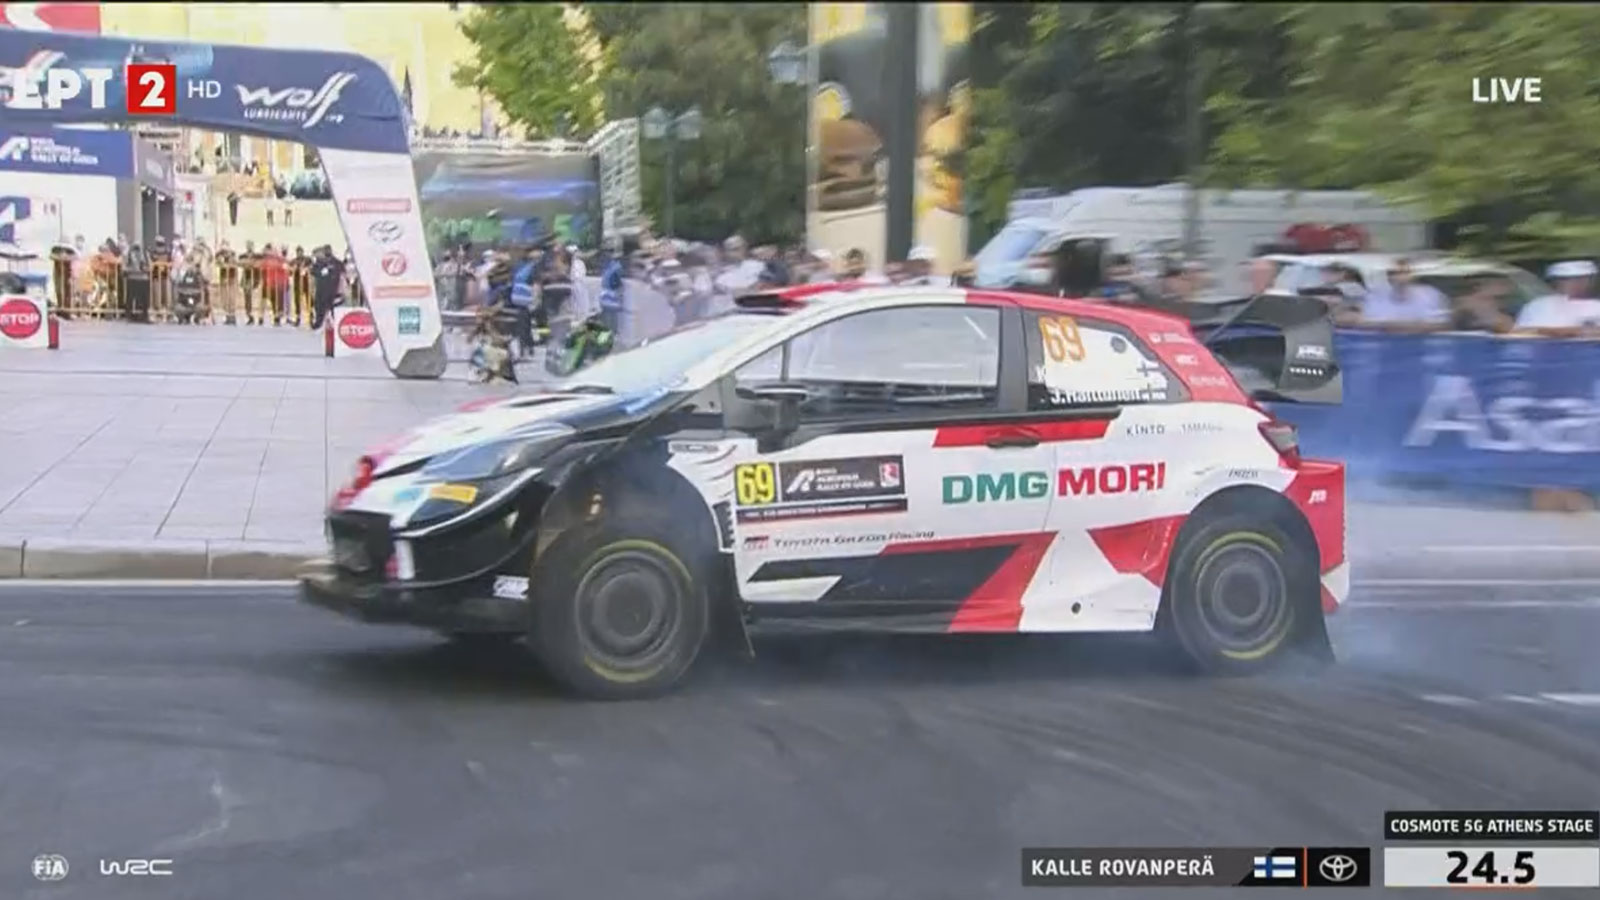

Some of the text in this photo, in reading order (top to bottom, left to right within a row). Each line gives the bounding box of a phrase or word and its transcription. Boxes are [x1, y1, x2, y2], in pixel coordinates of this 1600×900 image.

[1038, 315, 1085, 362] 69
[1127, 423, 1165, 438] KINTO
[735, 463, 776, 505] 69
[942, 471, 1048, 504] DMG
[1058, 462, 1166, 497] MORI
